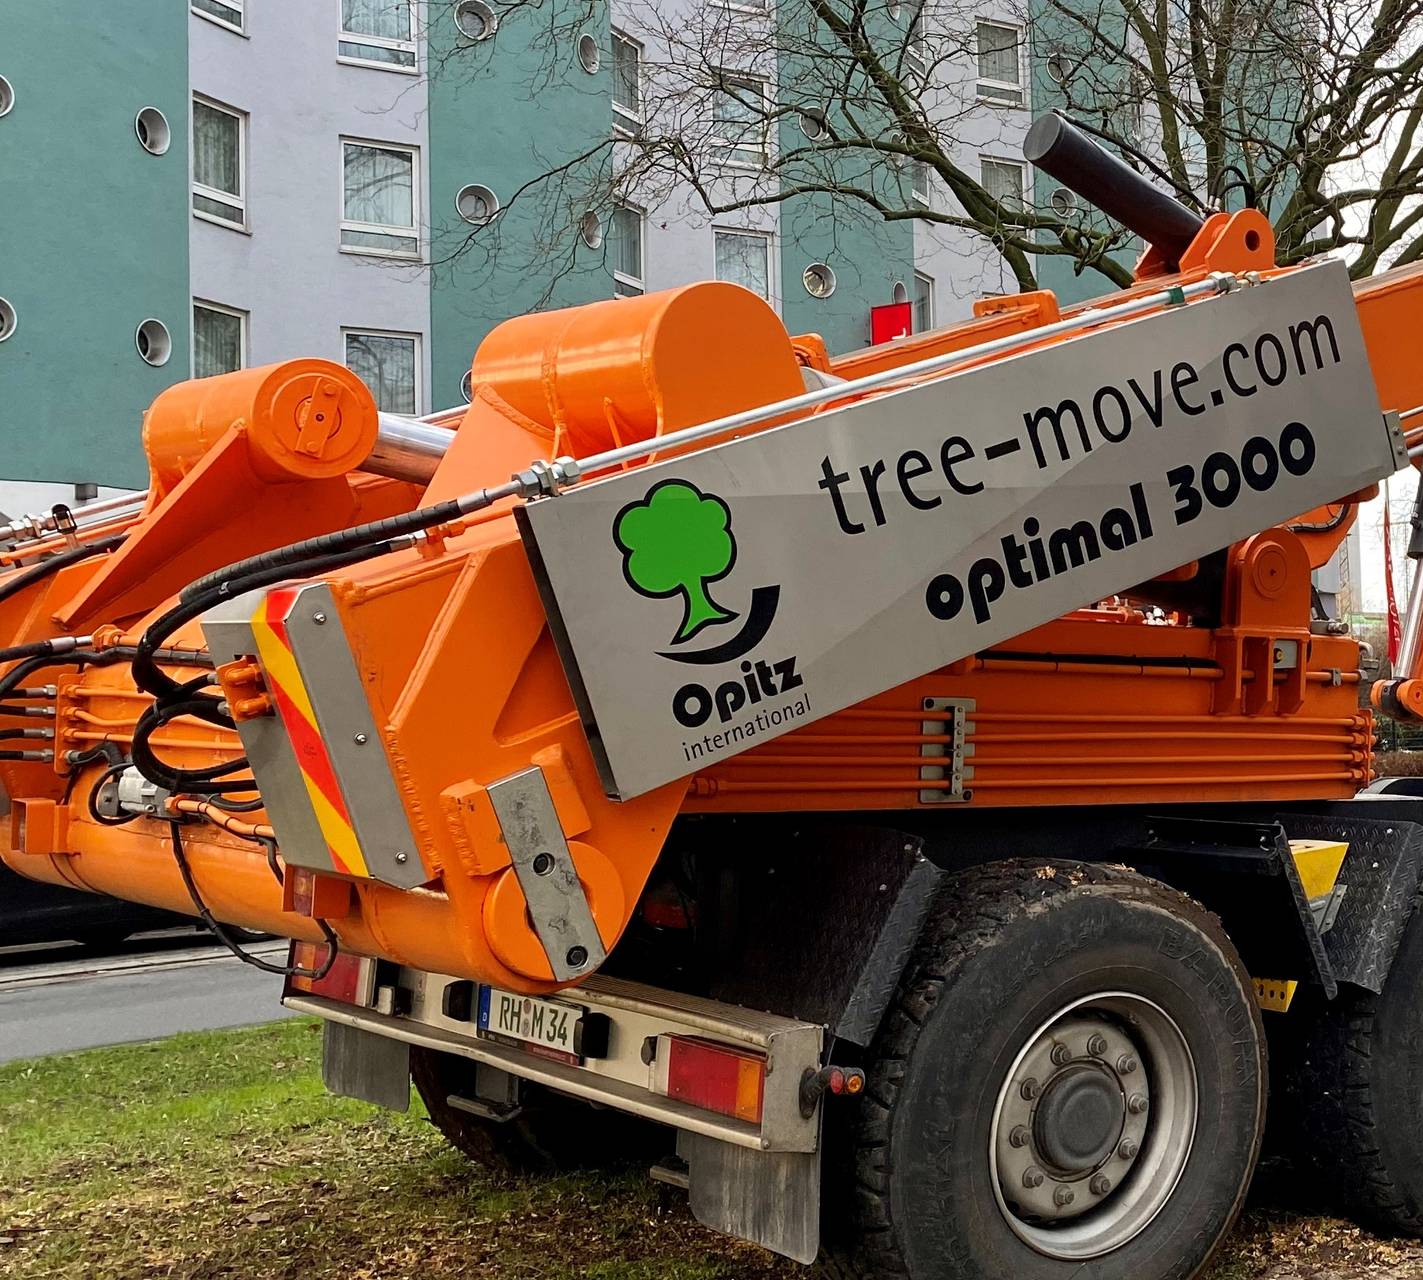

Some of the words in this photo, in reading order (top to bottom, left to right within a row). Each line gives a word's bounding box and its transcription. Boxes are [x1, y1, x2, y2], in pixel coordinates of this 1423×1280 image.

[817, 313, 1341, 536] tree-move.com
[925, 481, 1154, 623] optimal
[1165, 421, 1316, 525] 3000
[672, 655, 804, 728] Opitz
[682, 692, 812, 762] international
[499, 996, 522, 1034] RH
[531, 1003, 545, 1040] M
[546, 1008, 568, 1046] 34
